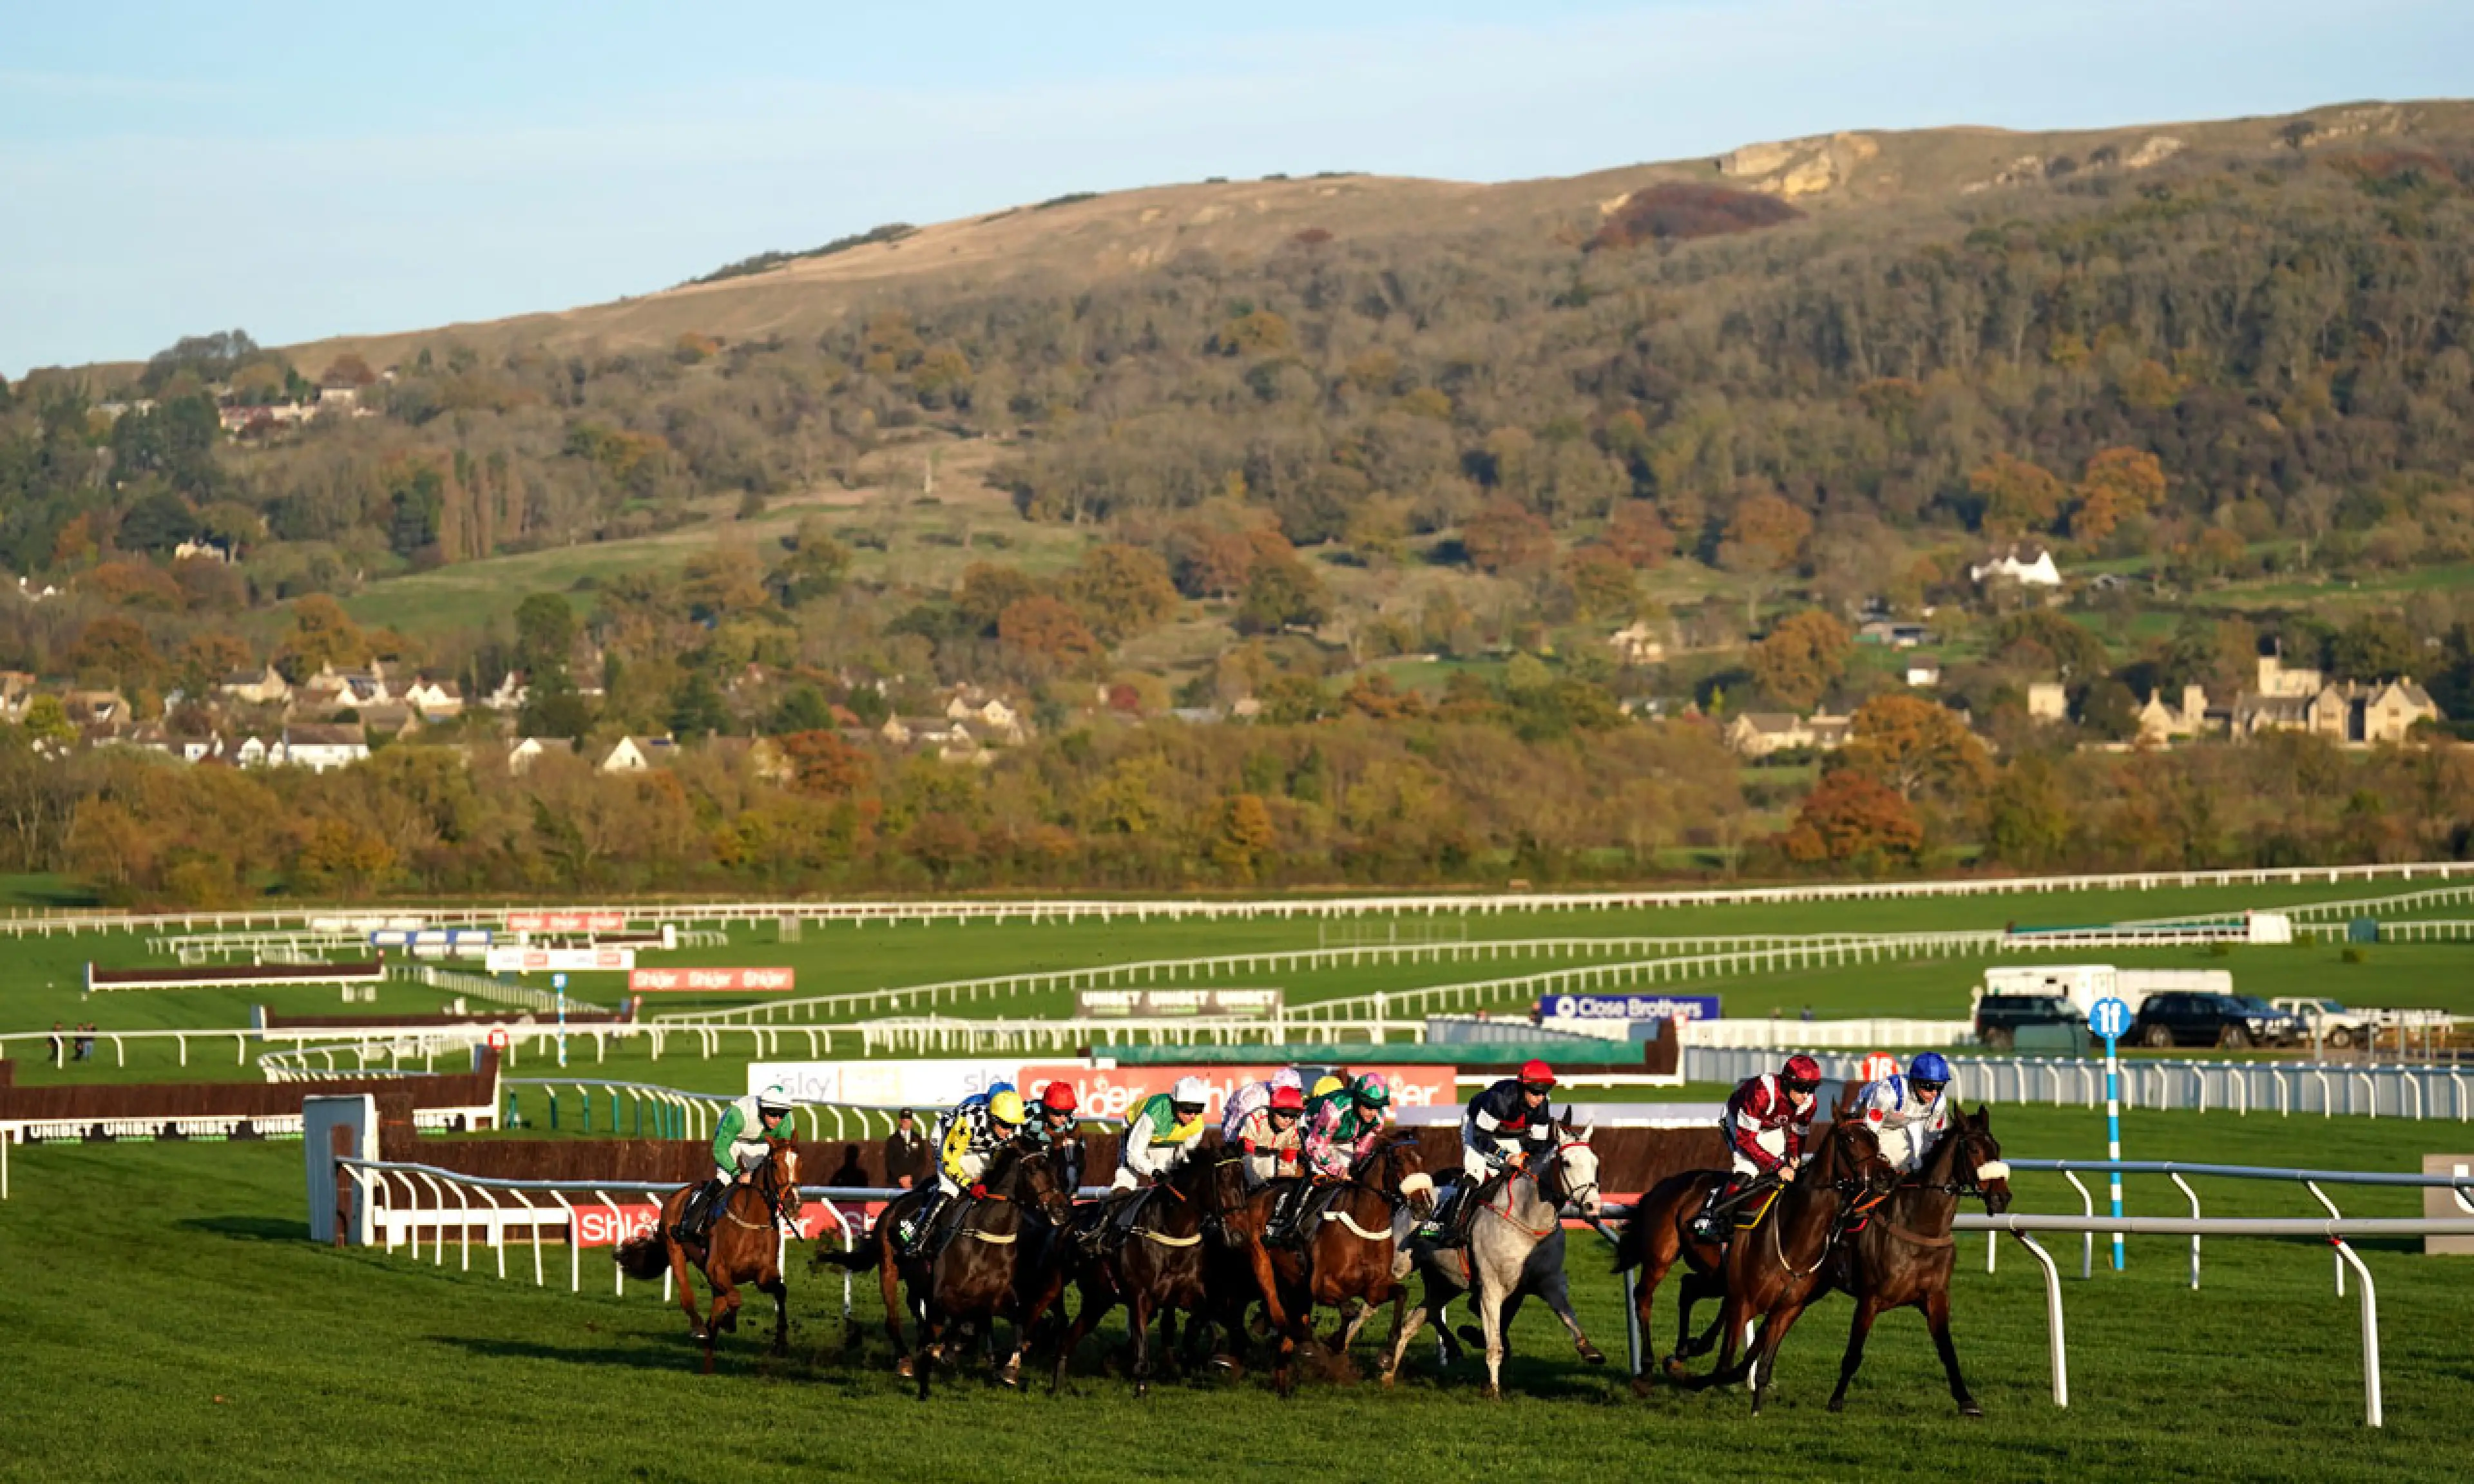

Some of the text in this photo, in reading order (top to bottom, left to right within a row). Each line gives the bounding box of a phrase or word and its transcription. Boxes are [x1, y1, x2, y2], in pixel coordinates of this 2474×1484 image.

[1579, 997, 1703, 1018] Close Brothers
[2098, 1002, 2122, 1033] 1f
[30, 1118, 304, 1139] UNIBET UNIBET UNIBET UNIBE
